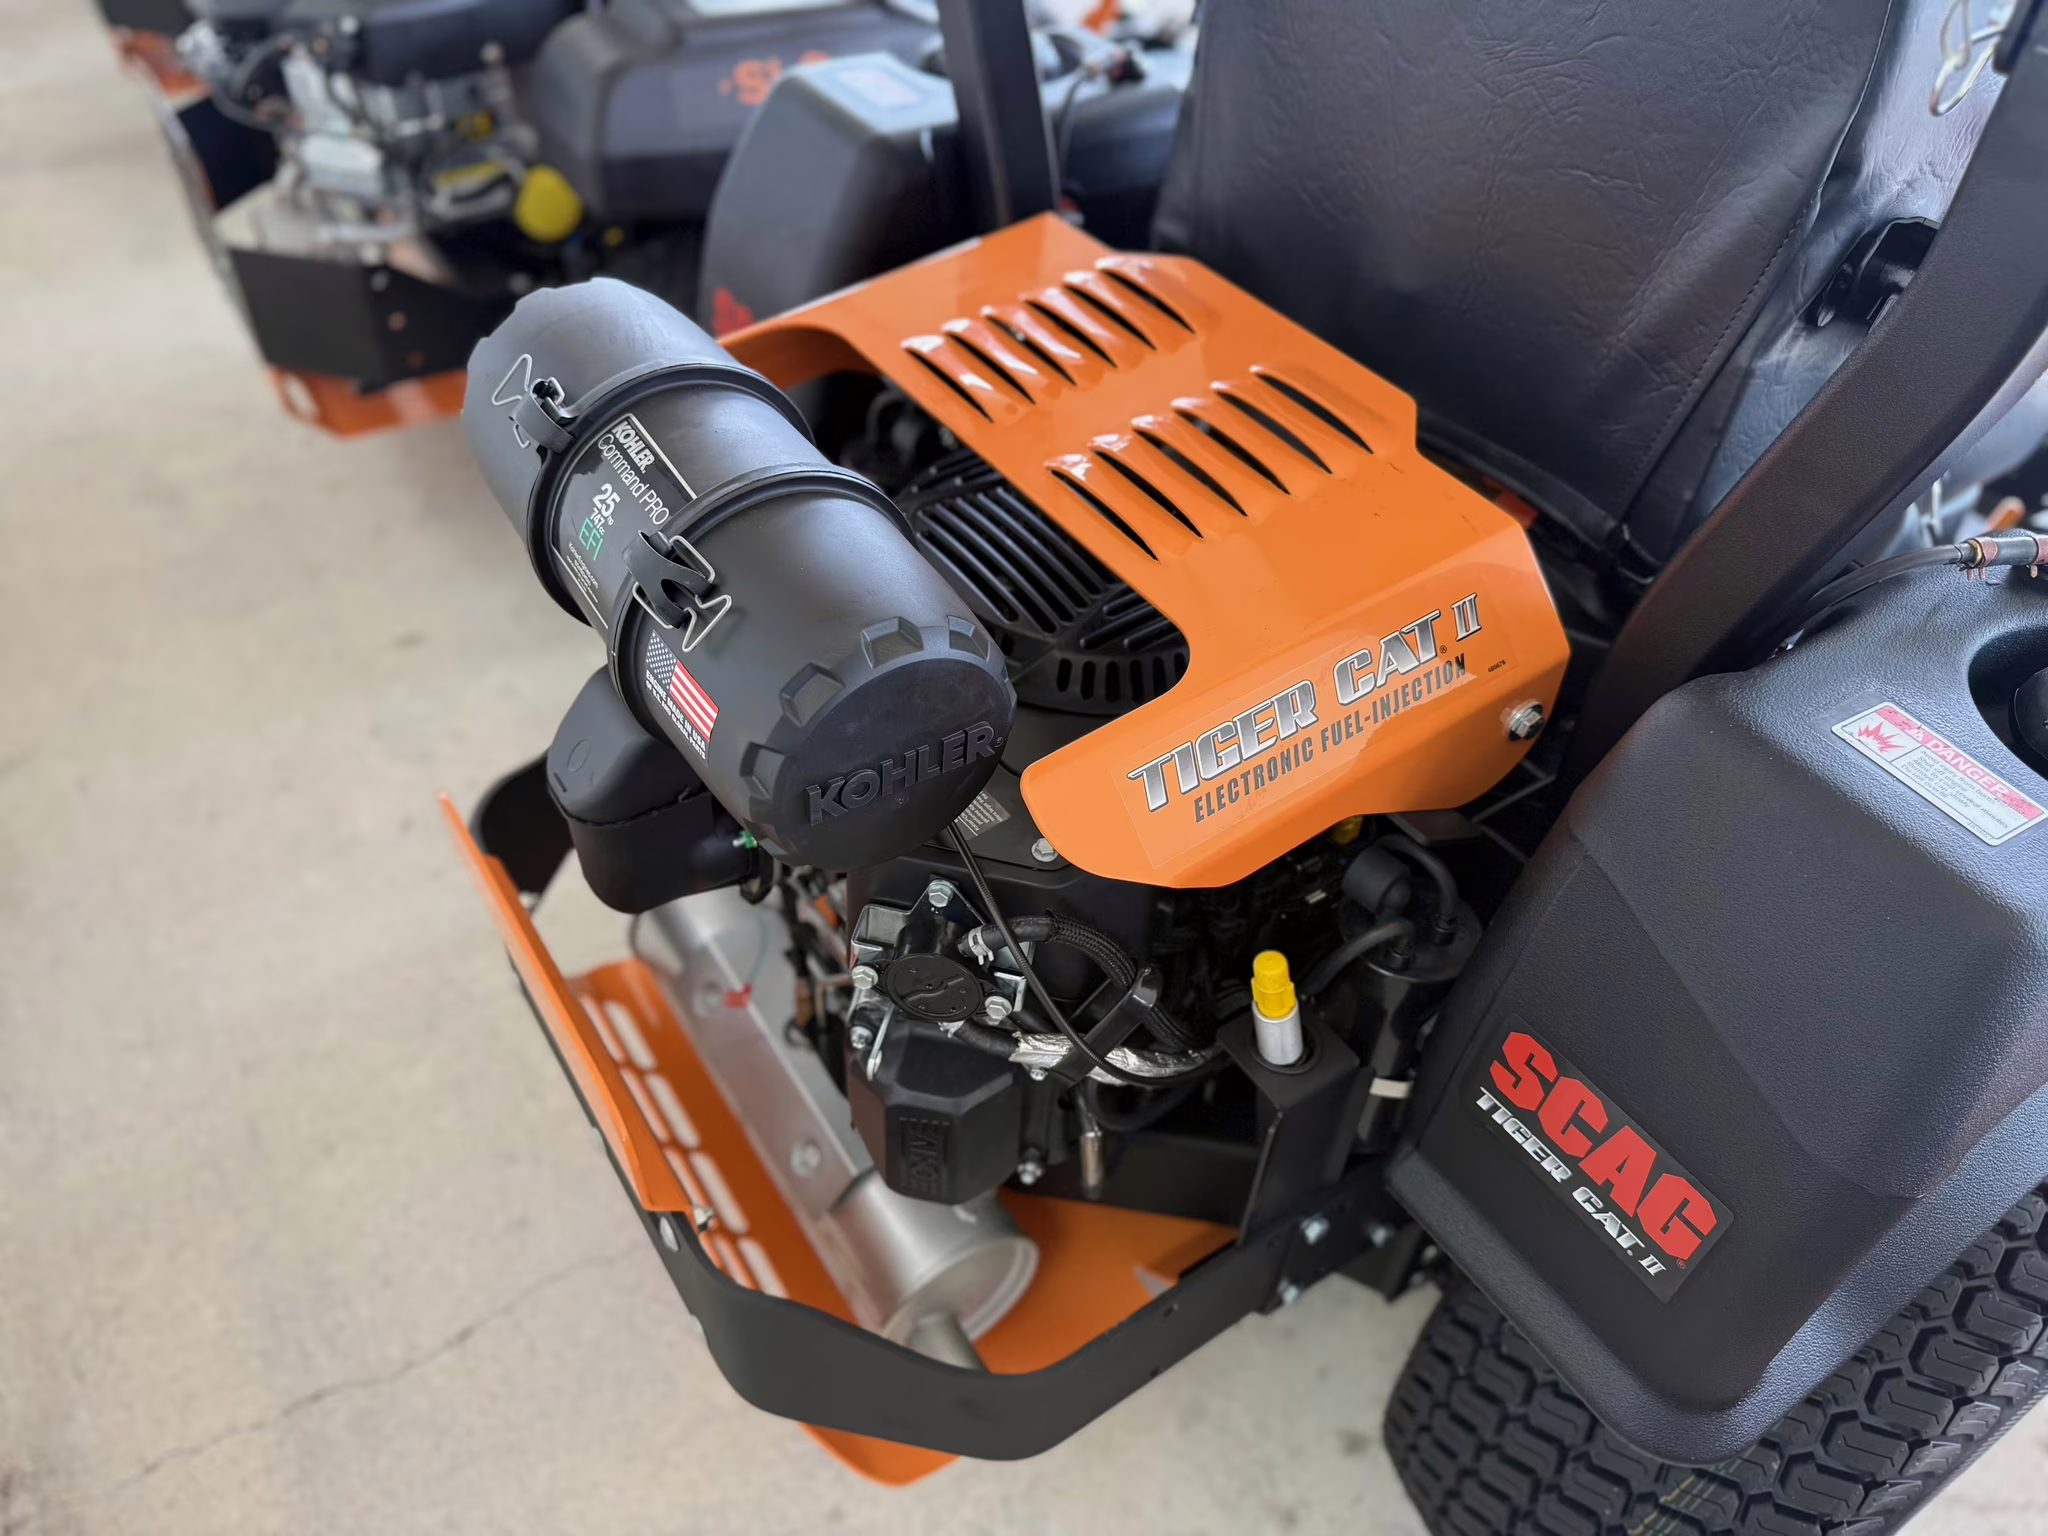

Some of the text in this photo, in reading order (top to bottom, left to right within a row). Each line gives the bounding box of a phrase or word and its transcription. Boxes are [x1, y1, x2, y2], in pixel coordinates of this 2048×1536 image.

[612, 420, 655, 474] KOHLER
[593, 483, 621, 526] 25 hp
[598, 433, 670, 525] Command PRO
[579, 516, 604, 561] EFI
[590, 507, 606, 529] 747
[646, 669, 706, 751] ENGINE MADE IN USA
[1126, 592, 1482, 812] TIGER CAT II
[689, 736, 706, 760] PARTS
[1194, 652, 1467, 823] ELECTRONIC FUEL-INJECTION
[1917, 755, 1934, 768] Shut
[1934, 767, 1945, 775] off
[805, 721, 995, 826] KOHLER
[1901, 764, 1912, 772] Do
[1912, 772, 1924, 781] not
[1907, 761, 1934, 782] Remove
[1935, 782, 1948, 792] cap
[1912, 758, 1931, 772] Allow
[1939, 778, 1956, 790] cool
[1955, 789, 1981, 808] several
[1981, 807, 2010, 829] minutes
[1924, 738, 2009, 799] DANGER
[1939, 763, 1959, 778] injury
[1959, 777, 1976, 789] from
[1489, 1031, 1719, 1261] SCAG
[1476, 1086, 1667, 1277] TIGER CAT II
